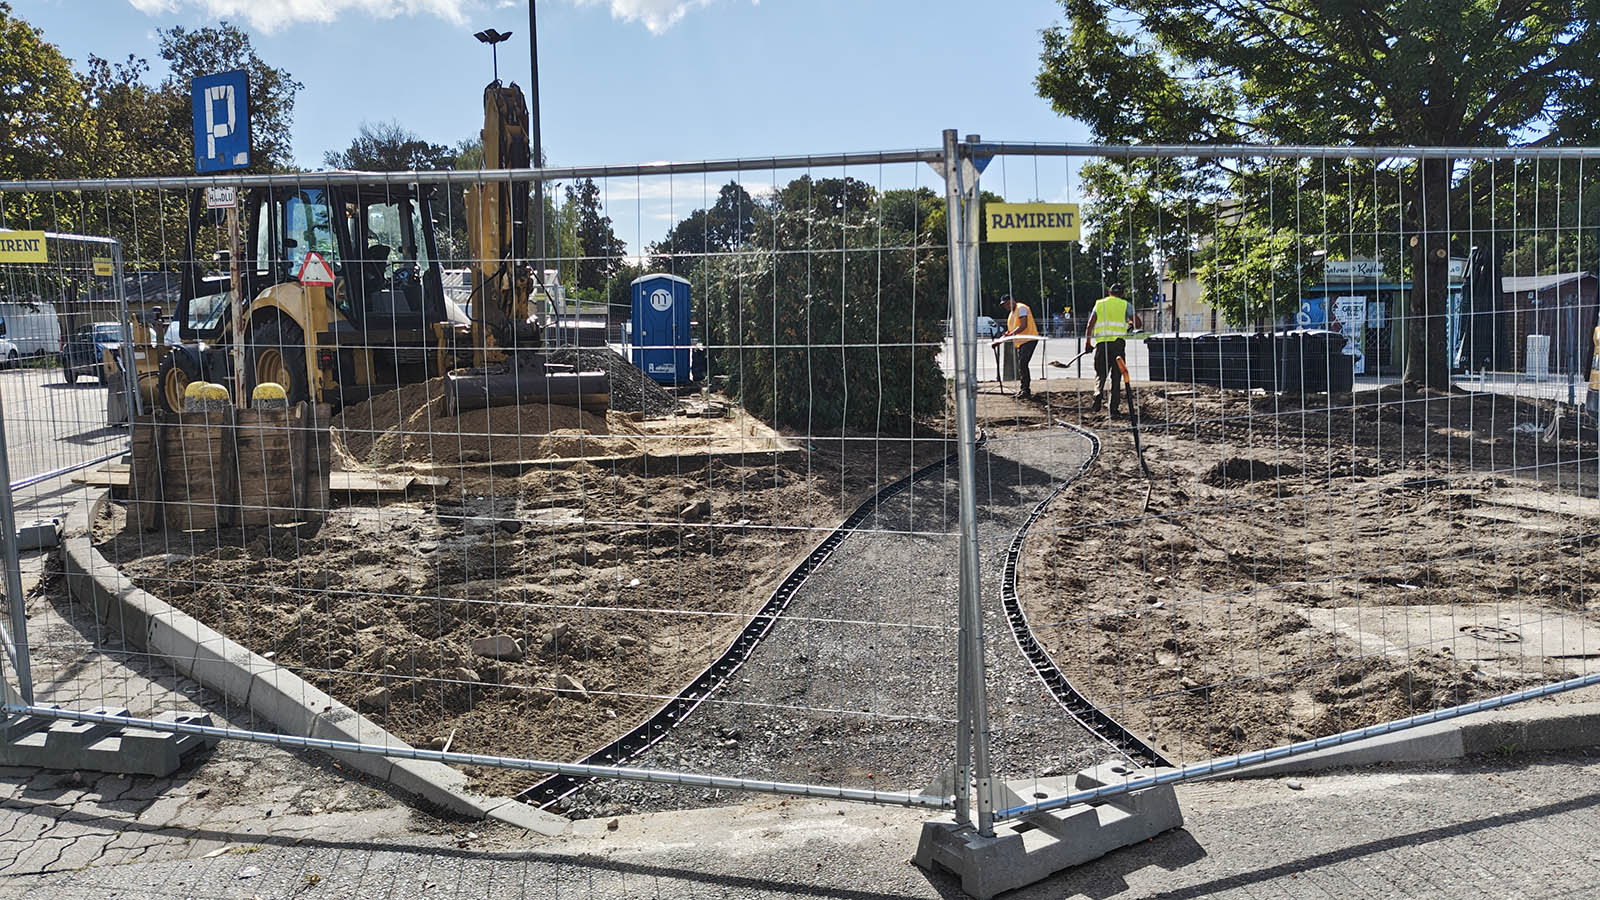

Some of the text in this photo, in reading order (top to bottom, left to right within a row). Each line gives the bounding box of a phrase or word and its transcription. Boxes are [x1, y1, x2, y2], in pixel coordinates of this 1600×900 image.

[204, 84, 236, 160] P
[991, 212, 1074, 229] RAMIRENT
[0, 239, 40, 252] IRENT
